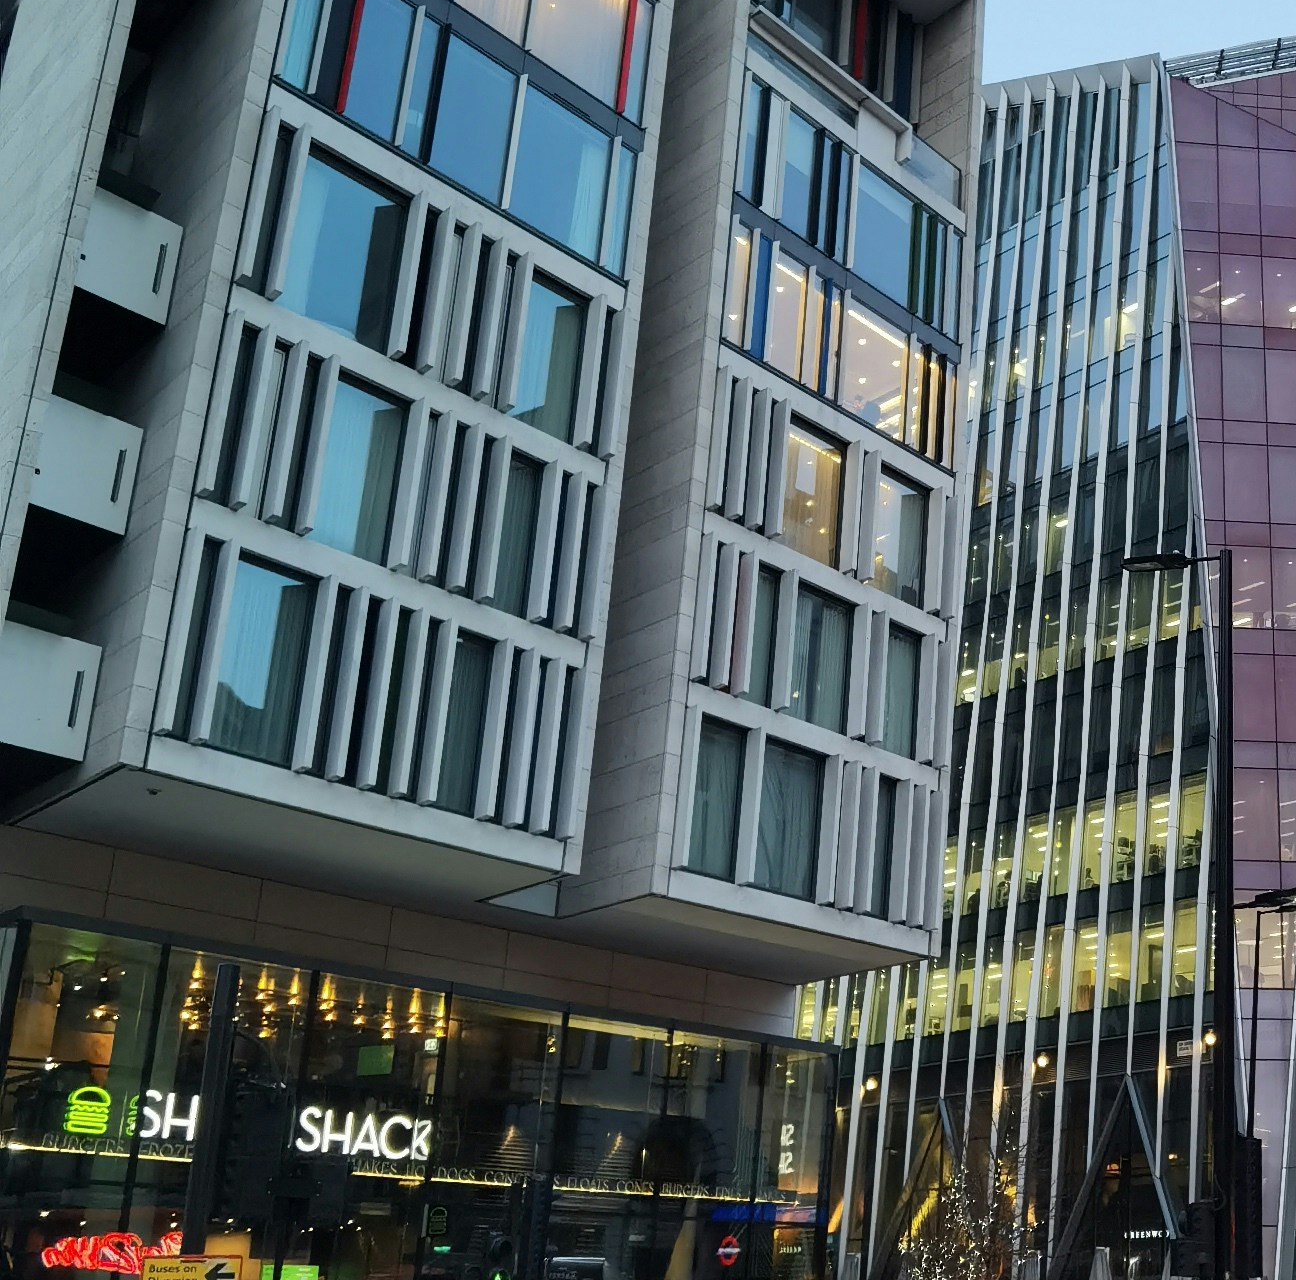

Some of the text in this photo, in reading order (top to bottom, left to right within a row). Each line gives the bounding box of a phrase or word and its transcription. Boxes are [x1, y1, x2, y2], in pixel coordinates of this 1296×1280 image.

[294, 1104, 432, 1160] SHACK
[139, 1140, 195, 1158] FROZE
[350, 1157, 398, 1176] HAKES
[149, 1264, 197, 1273] Buses on
